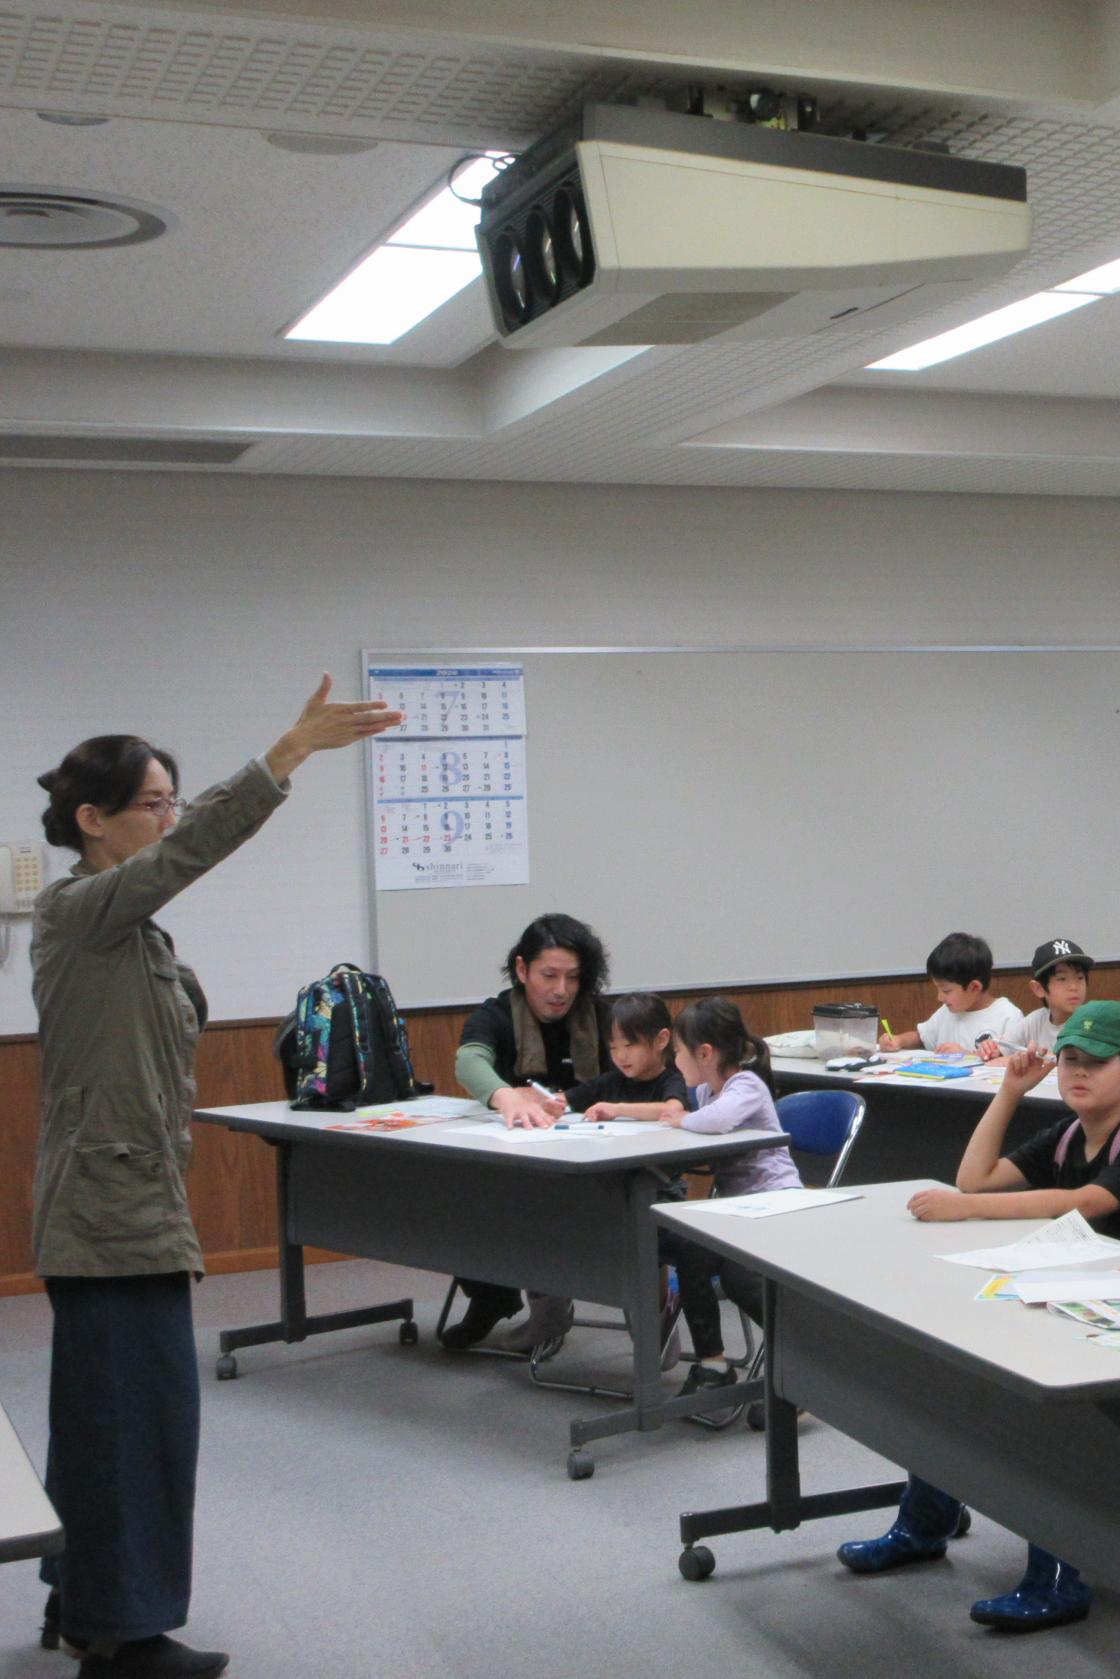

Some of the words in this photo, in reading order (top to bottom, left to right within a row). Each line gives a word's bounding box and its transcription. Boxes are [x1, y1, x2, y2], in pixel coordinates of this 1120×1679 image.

[437, 691, 460, 724] 7
[440, 752, 462, 786] 8
[440, 811, 464, 845] 9
[1053, 940, 1072, 955] NY
